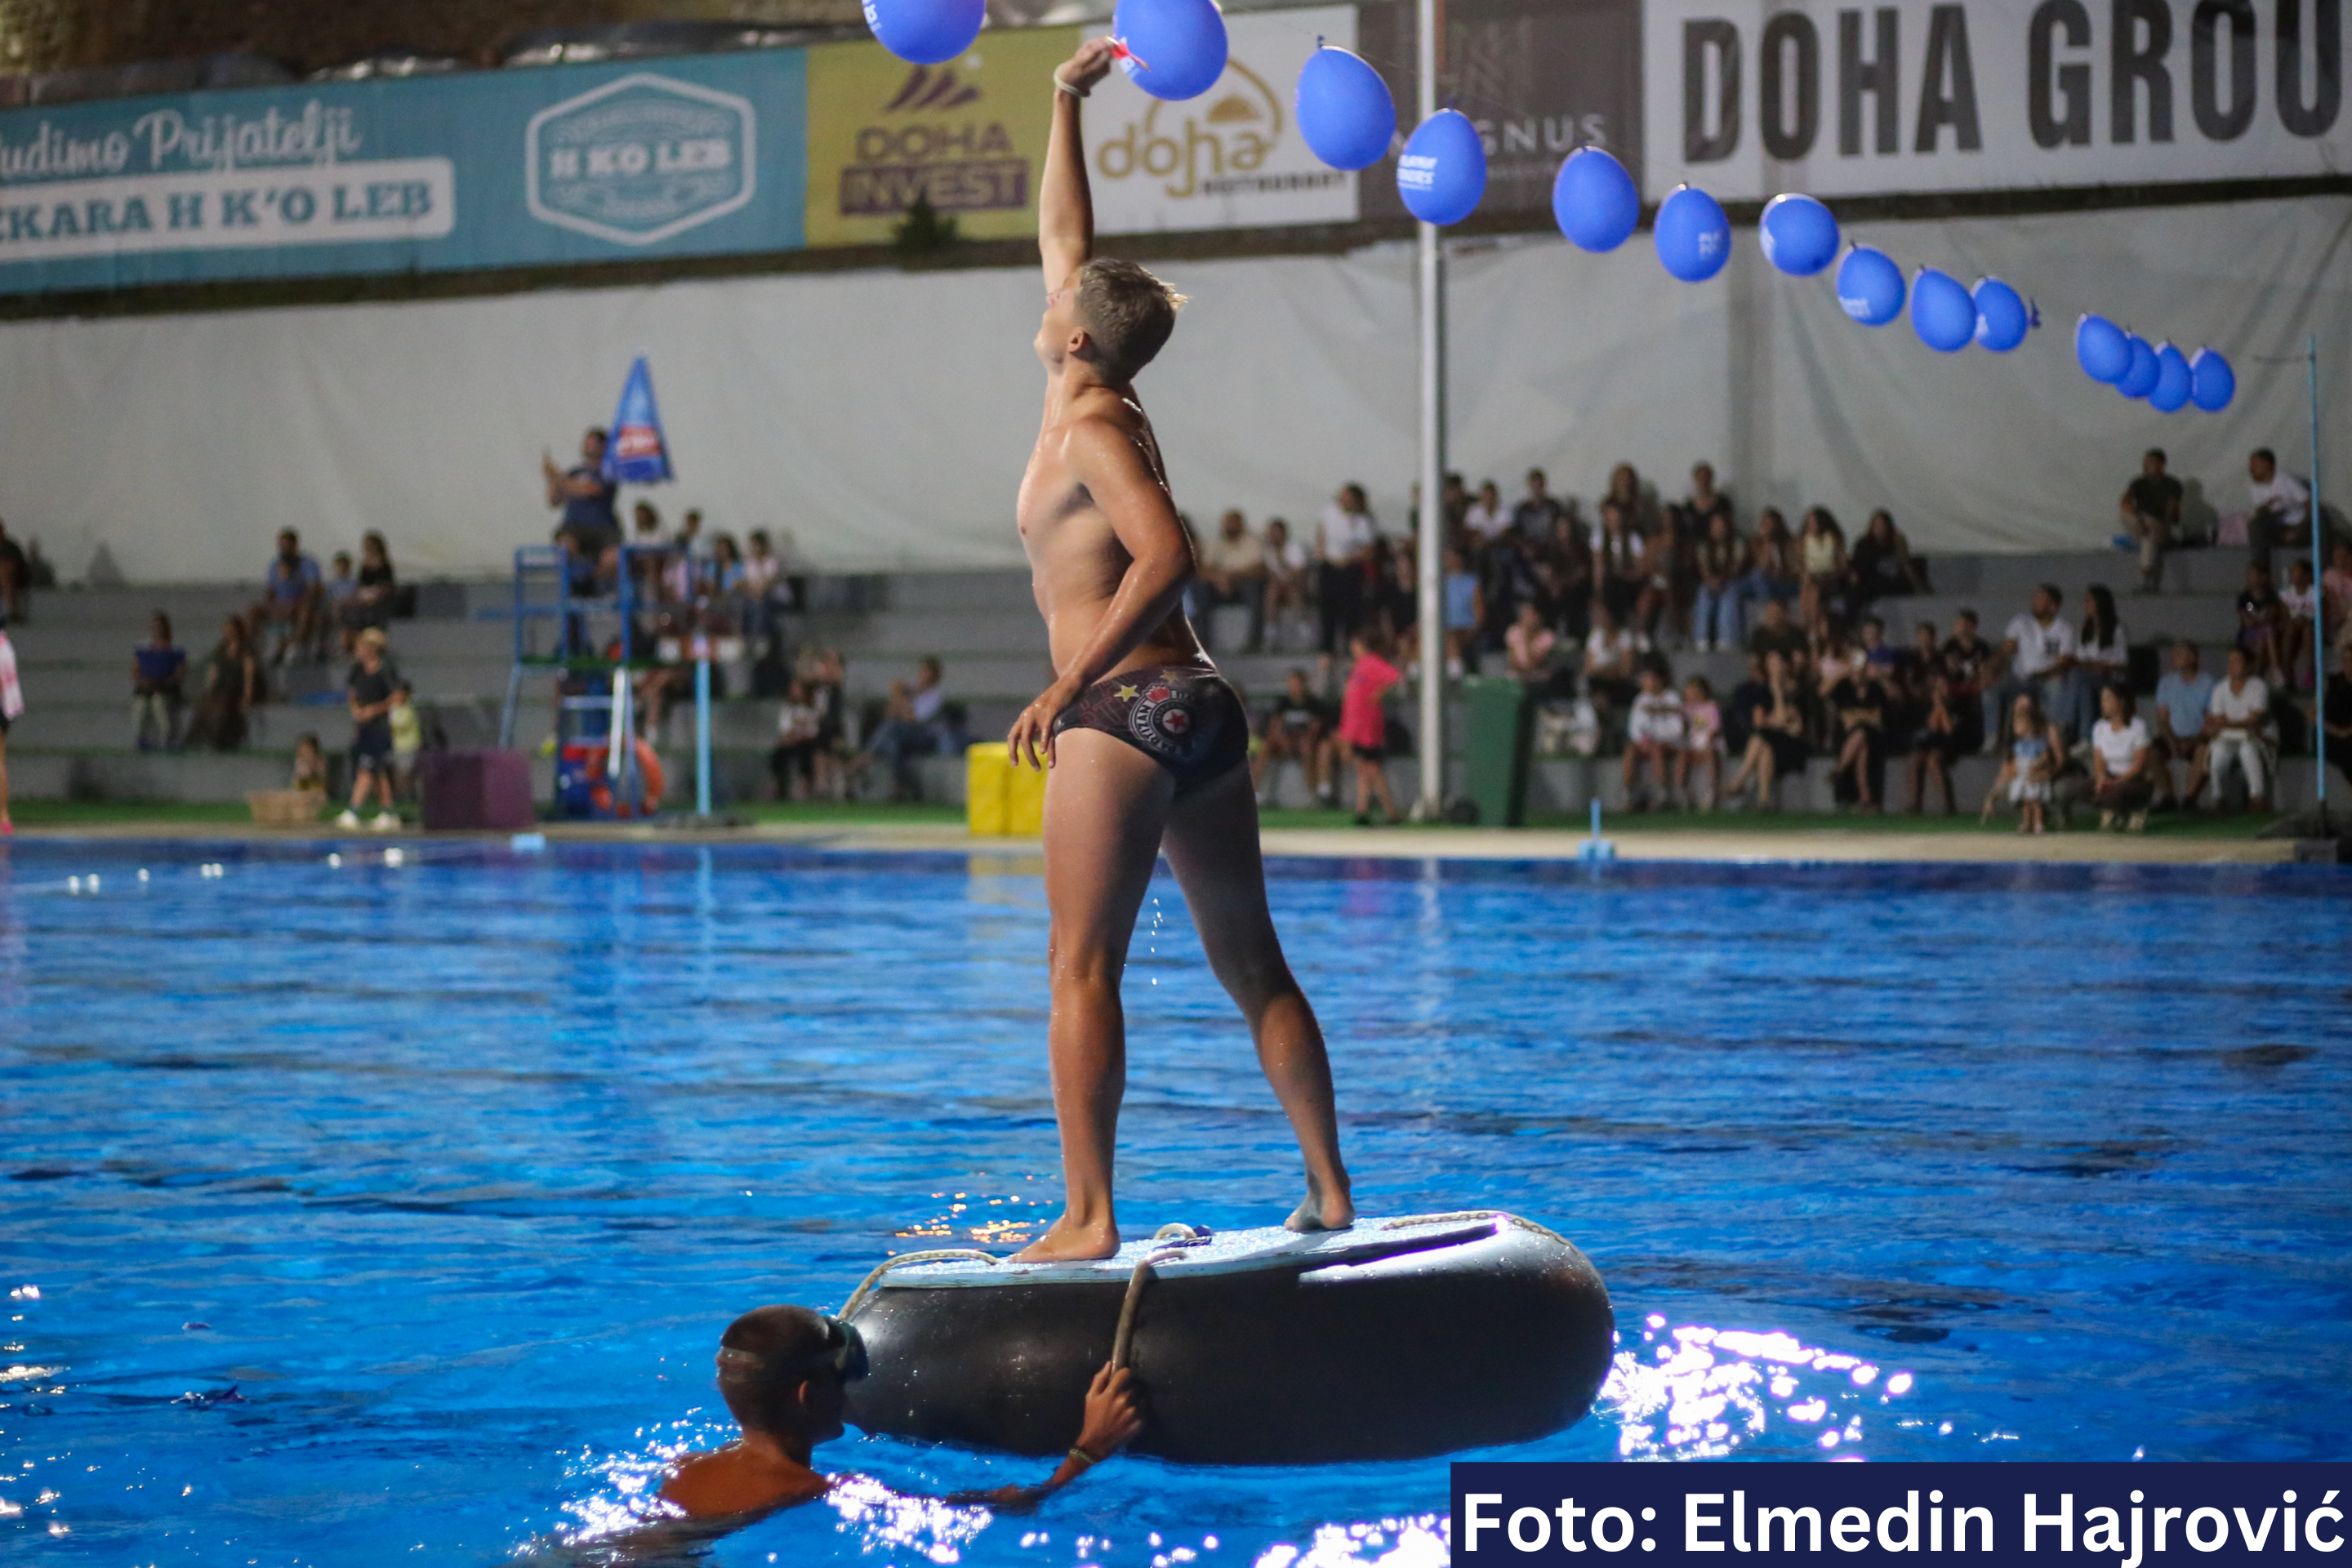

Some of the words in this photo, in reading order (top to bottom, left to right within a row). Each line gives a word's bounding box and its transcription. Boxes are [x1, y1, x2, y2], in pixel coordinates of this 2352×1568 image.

[1683, 3, 1984, 163] DOHA
[2028, 0, 2342, 150] GROU
[133, 99, 363, 173] Prijatelji
[855, 122, 1015, 163] DOHA
[1096, 119, 1276, 198] doha
[168, 191, 203, 229] H
[332, 179, 432, 224] LEB
